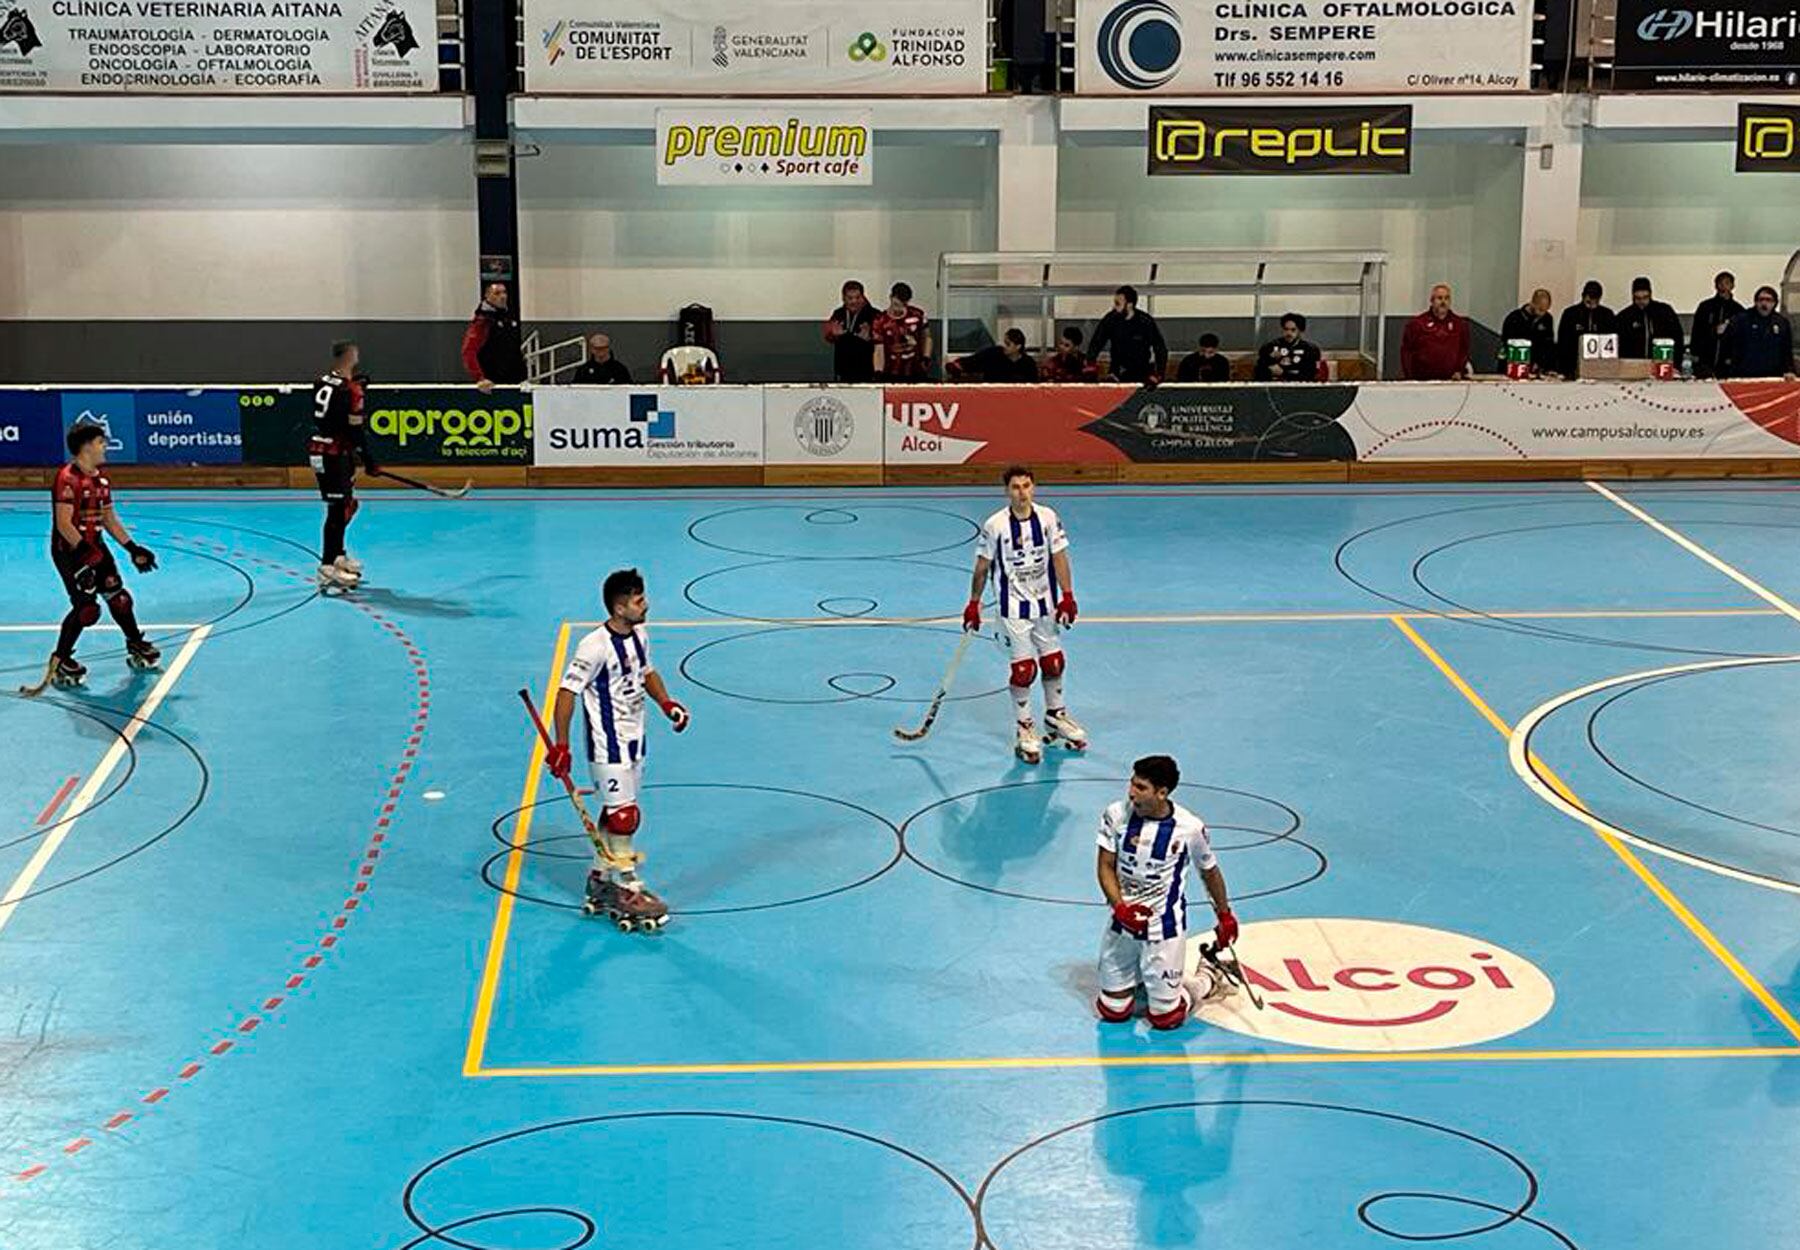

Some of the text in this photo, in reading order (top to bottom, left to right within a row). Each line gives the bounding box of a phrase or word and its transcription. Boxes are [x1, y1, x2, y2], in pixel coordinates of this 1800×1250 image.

[137, 2, 266, 17] VETERINARIA
[271, 2, 342, 17] AITANA
[1695, 10, 1800, 38] Hilari
[69, 27, 330, 41] TRAUMATOLOGÍA DERMATOLOGÍA
[569, 31, 660, 45] COMUNITAT
[732, 35, 809, 46] GENERALITAT
[1215, 25, 1376, 41] Drs. SEMPERE
[206, 44, 311, 56] LABORATORIO
[576, 47, 672, 60] DE L'ESPORT
[735, 48, 808, 59] VALENCIANA
[892, 40, 965, 52] TRINIDAD
[892, 54, 965, 66] ALFONSO
[1215, 49, 1376, 63] www.clinicasempere.com
[89, 58, 312, 71] ONCOLOGÍA OFTALMOLOGÍA
[82, 72, 321, 86] ENDOCRINOLOGÍA ECOGRAFÍA
[1214, 71, 1343, 87] Tlf 96 552 14 16
[1407, 74, 1420, 87] C/
[1422, 74, 1455, 87] Oliver
[1487, 73, 1519, 88] Alcoy
[665, 118, 868, 165] premium
[776, 160, 820, 176] Sport
[1586, 338, 1615, 354] 0 4
[314, 384, 334, 418] 9
[887, 402, 960, 430] UPV
[1171, 405, 1233, 414] UNIVERSITAT
[147, 411, 194, 426] unión
[370, 404, 533, 446] aproop!
[550, 427, 644, 450] suma
[1531, 421, 1704, 441] www.campusalcoi.upv.es
[148, 431, 243, 449] deportistas
[901, 436, 943, 452] Alcoi
[608, 779, 619, 792] 2
